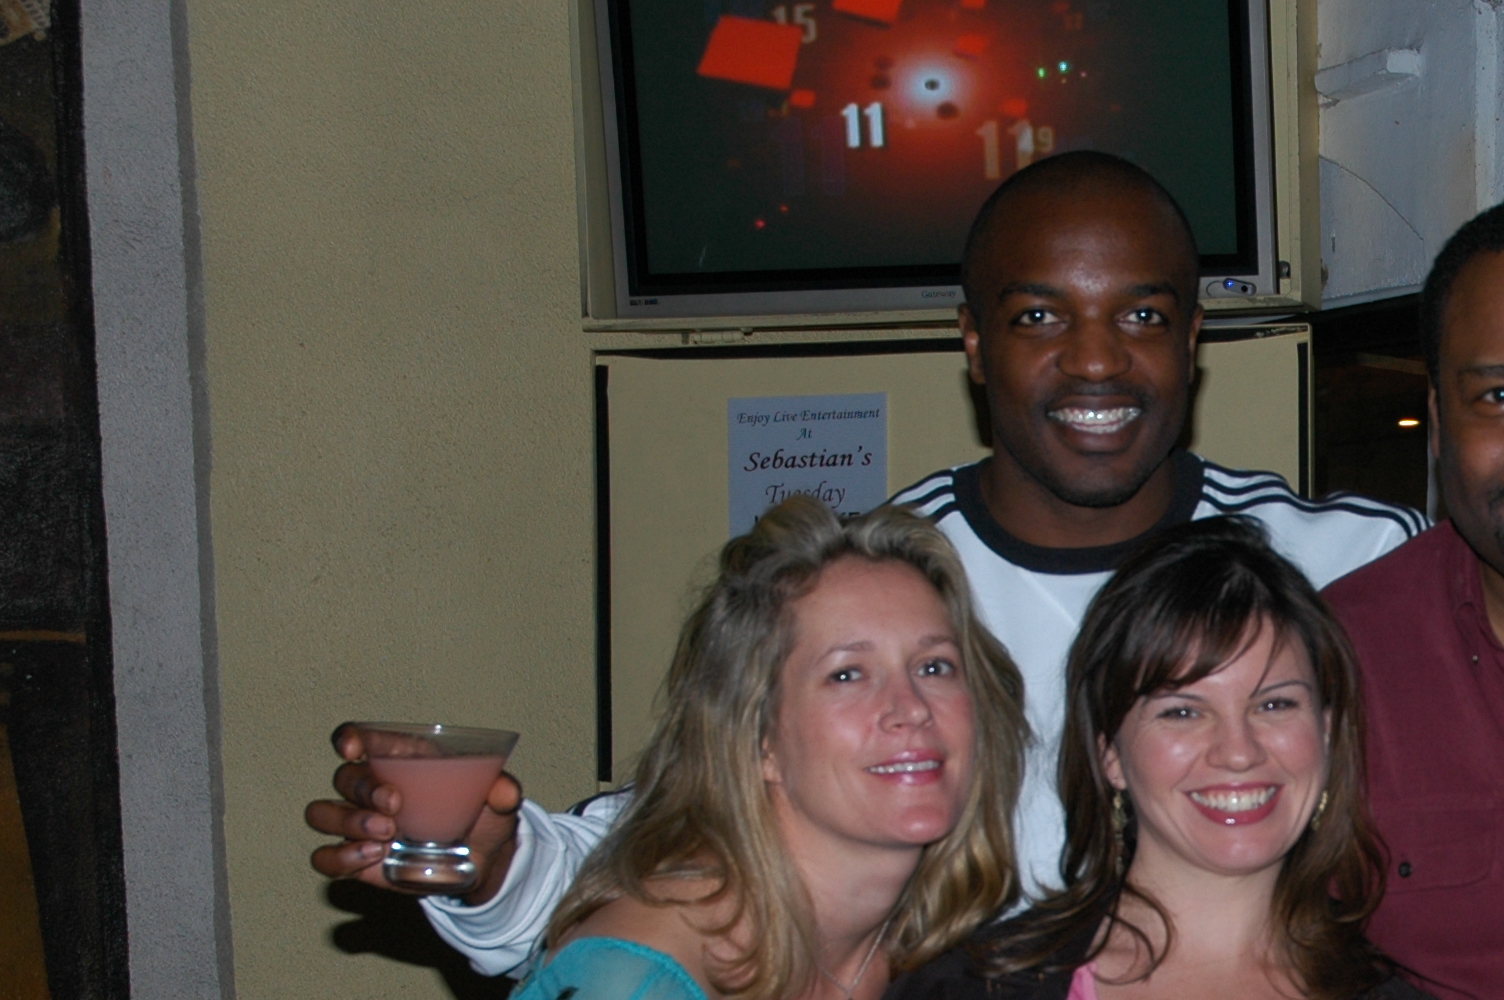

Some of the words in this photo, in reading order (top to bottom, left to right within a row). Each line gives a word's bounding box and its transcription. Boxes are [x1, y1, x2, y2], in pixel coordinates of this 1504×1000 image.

[839, 101, 886, 149] 11
[737, 412, 770, 427] Enjoy
[773, 410, 798, 423] Live
[800, 408, 880, 422] Entertainment
[796, 427, 813, 441] At
[744, 445, 873, 472] Sebastian's
